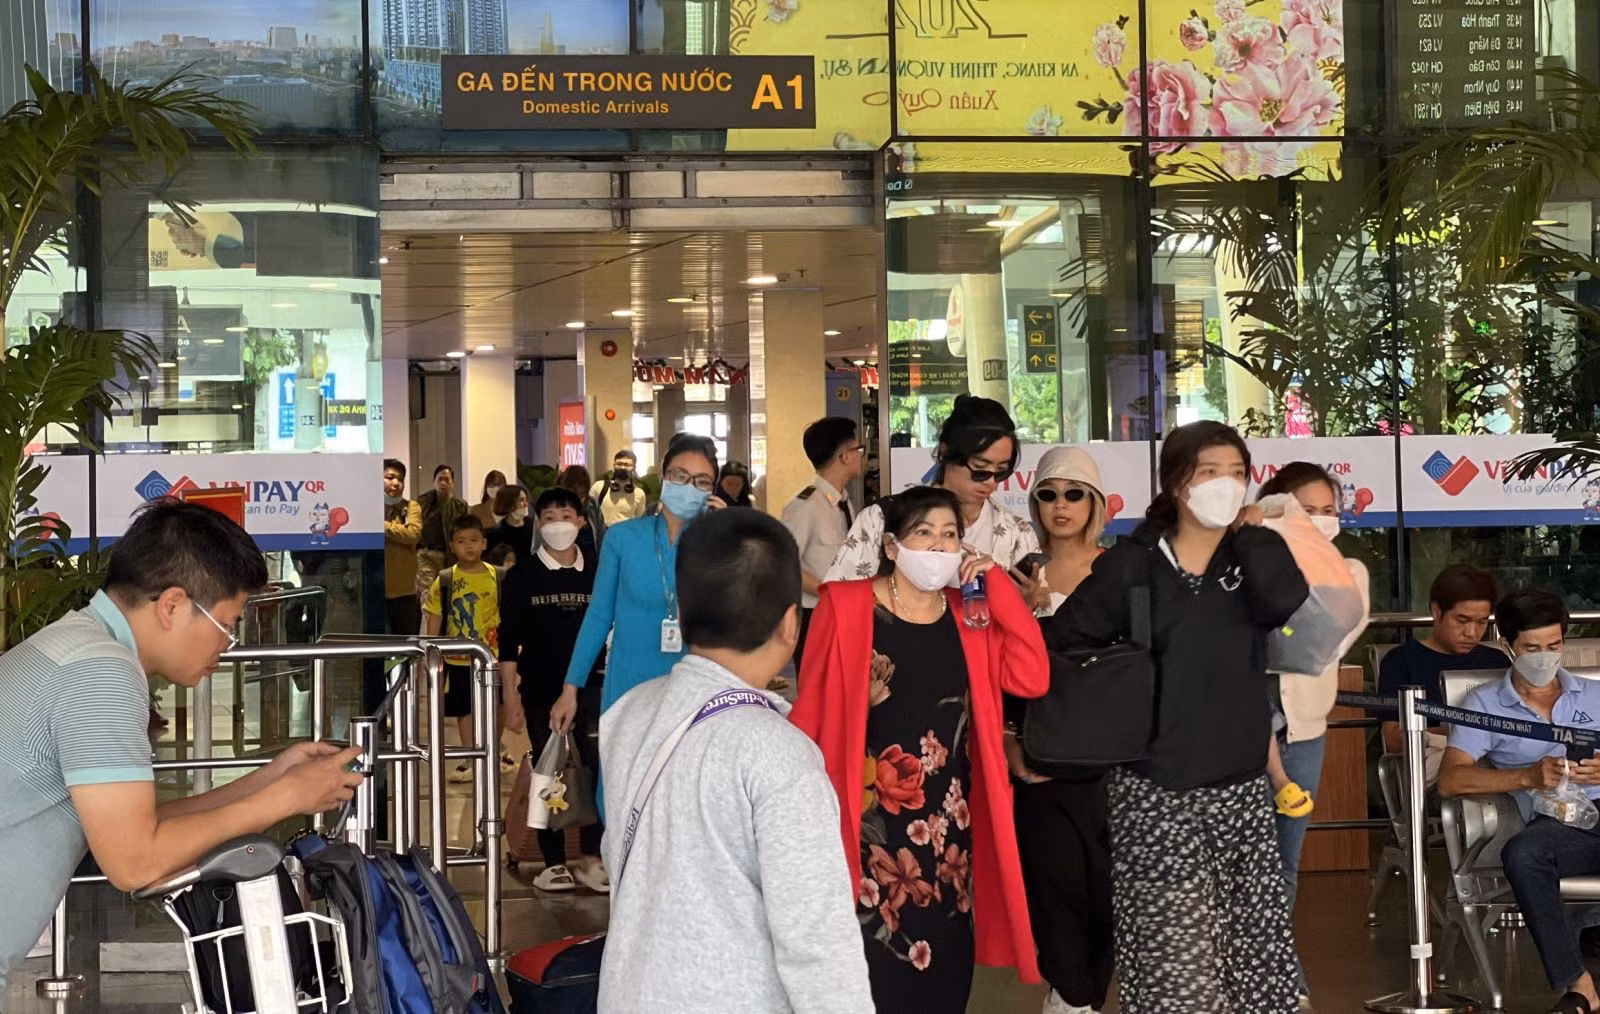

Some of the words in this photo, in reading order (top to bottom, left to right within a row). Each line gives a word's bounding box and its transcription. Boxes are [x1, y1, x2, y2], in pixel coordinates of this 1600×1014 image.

[457, 72, 494, 92] GA
[502, 64, 555, 92] ĐẾN
[563, 72, 652, 92] TRONG
[662, 67, 733, 92] NƯỚC
[751, 74, 803, 110] A1
[523, 100, 601, 114] Domestic
[605, 100, 669, 114] Arrivals
[1333, 463, 1351, 475] QR
[305, 481, 325, 493] QR
[245, 505, 262, 515] an
[265, 504, 276, 515] to
[279, 503, 300, 516] Pay
[1552, 727, 1574, 743] TIA
